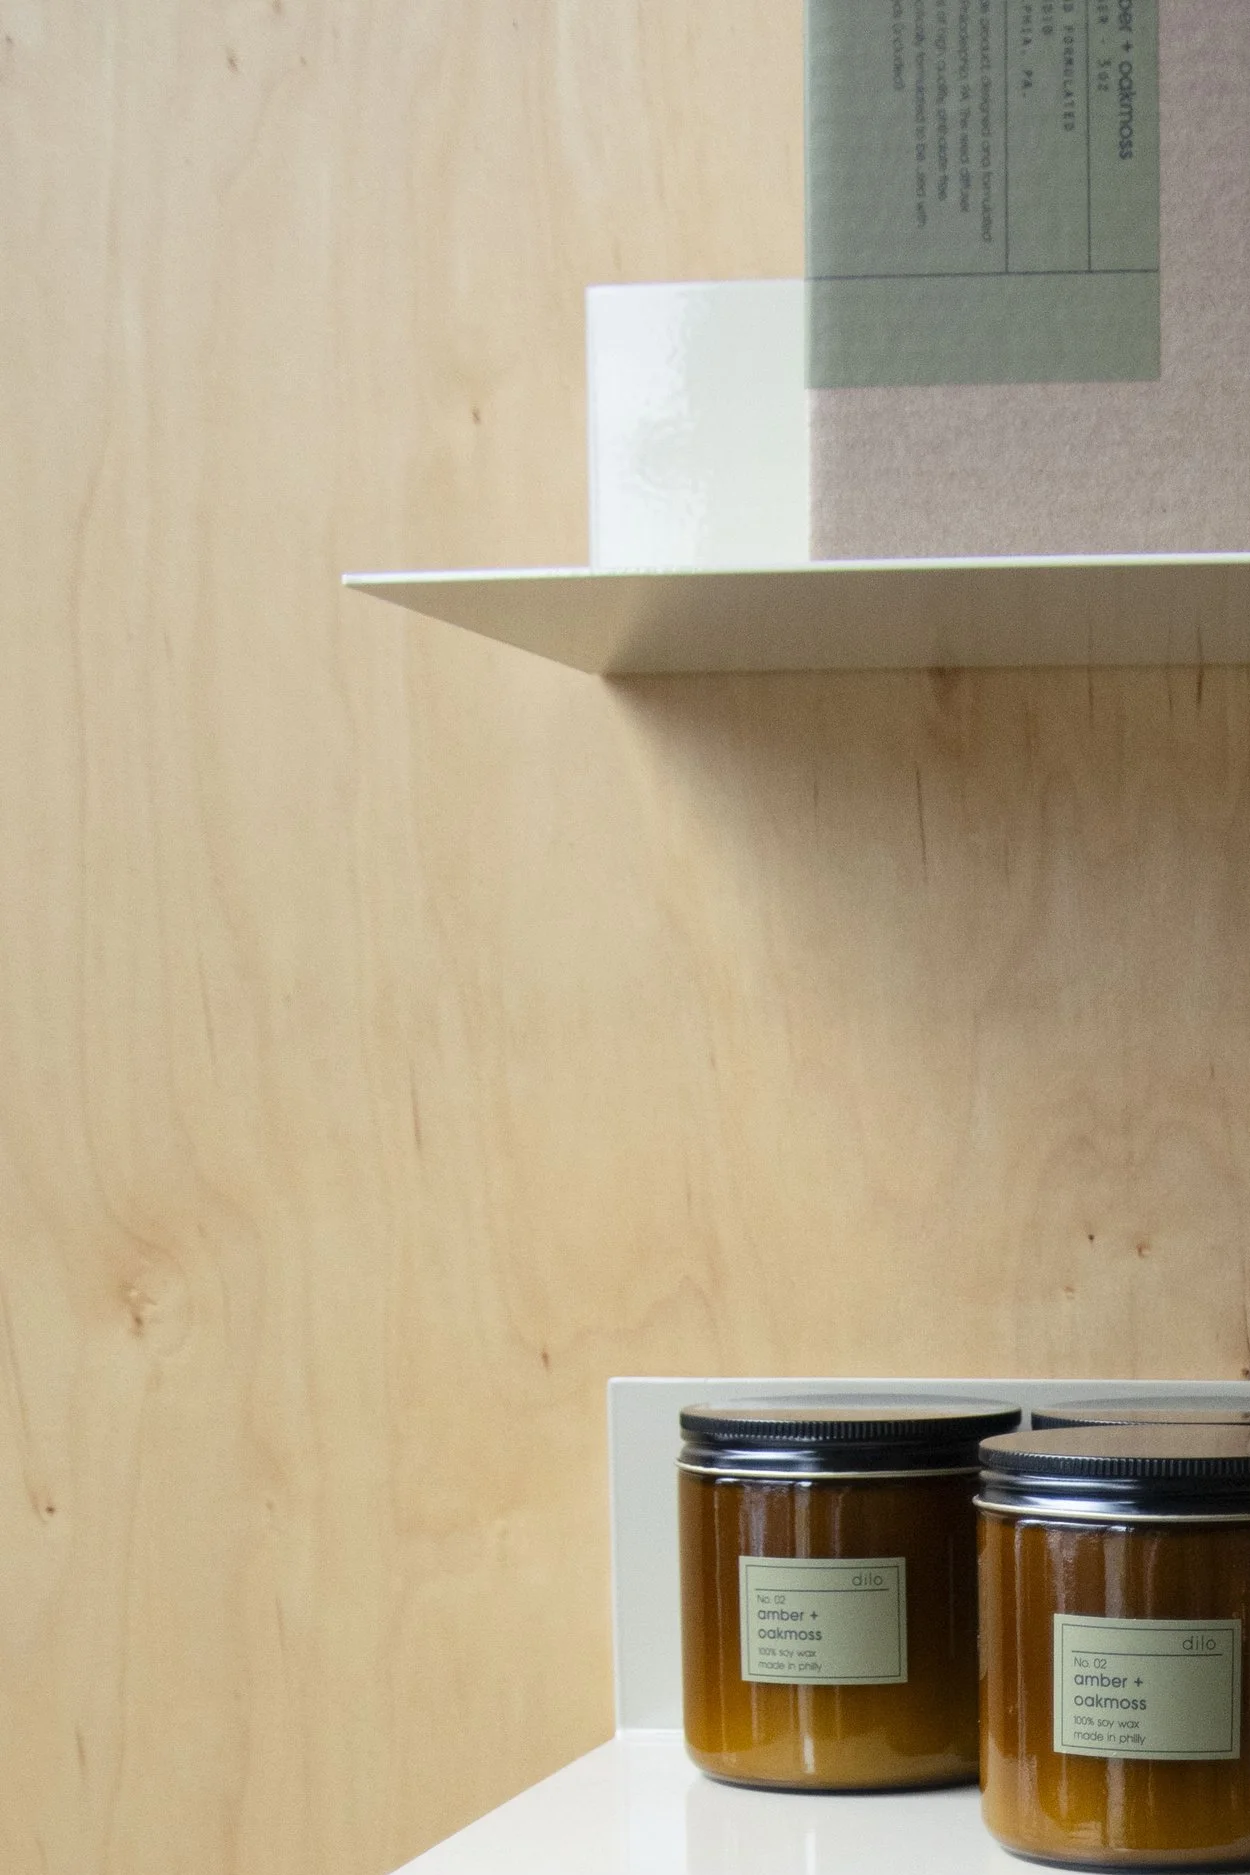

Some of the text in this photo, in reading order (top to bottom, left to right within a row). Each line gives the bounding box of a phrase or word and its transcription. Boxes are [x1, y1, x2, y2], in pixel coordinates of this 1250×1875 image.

[1121, 40, 1134, 52] +
[1062, 25, 1075, 132] FORMULATED
[1118, 60, 1136, 160] oakmoss
[851, 1574, 883, 1587] dilo
[757, 1608, 819, 1622] amber +
[758, 1627, 823, 1641] oakmoss
[1182, 1635, 1217, 1651] dilo
[797, 1650, 817, 1658] wax
[758, 1660, 823, 1673] made in philly
[1073, 1656, 1108, 1670] No. 02
[1073, 1673, 1144, 1689] amber +
[1073, 1693, 1147, 1711] oakmoss
[1073, 1715, 1140, 1729] 100% soy wax
[1073, 1730, 1146, 1746] made in philly
